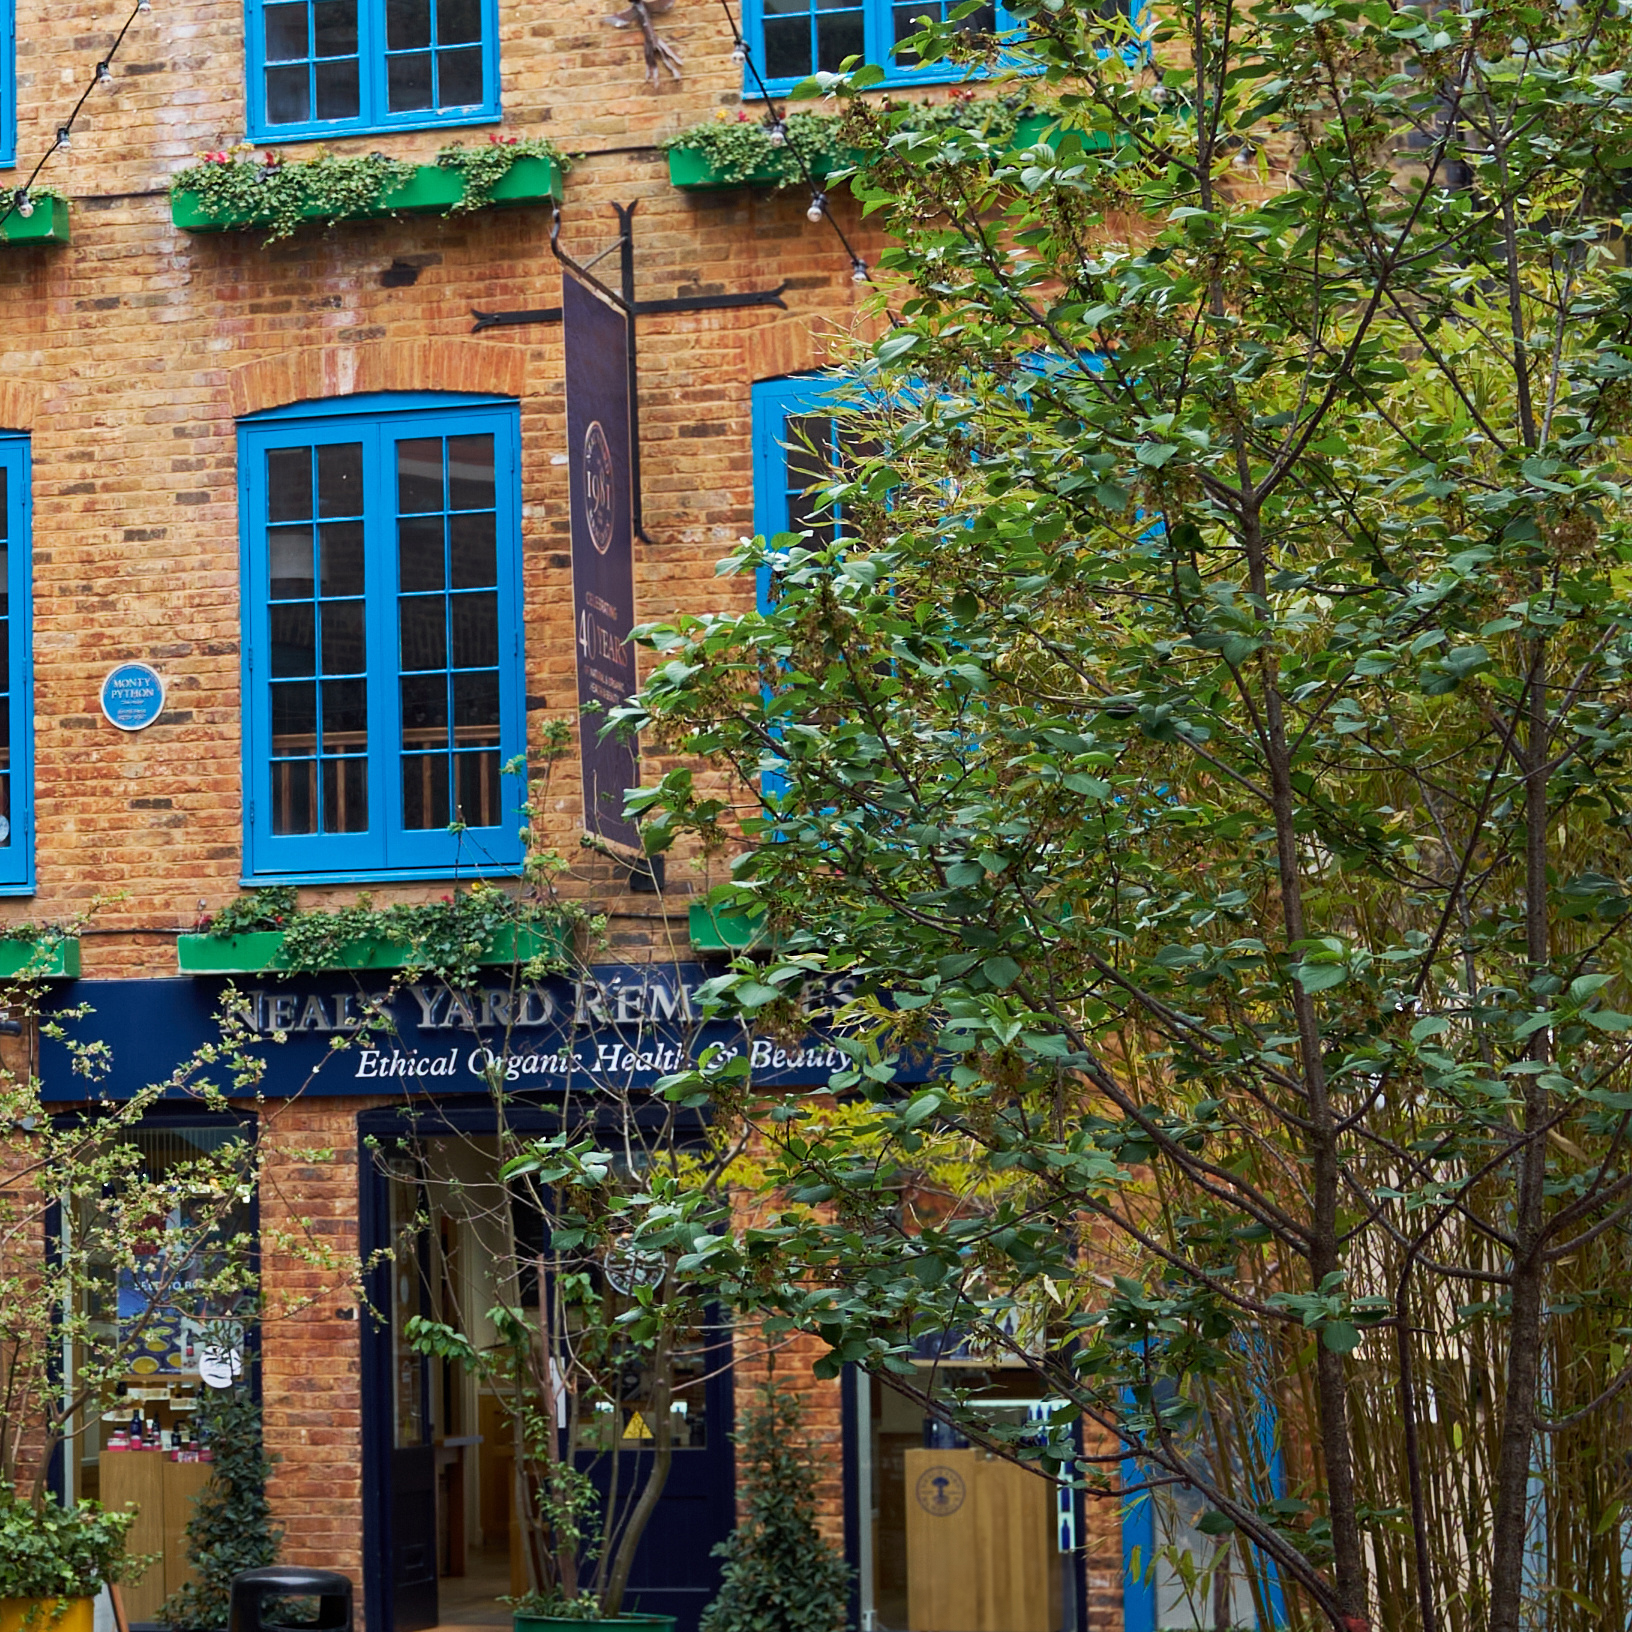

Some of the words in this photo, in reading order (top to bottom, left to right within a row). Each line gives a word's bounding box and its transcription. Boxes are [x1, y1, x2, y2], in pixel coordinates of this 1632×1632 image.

[587, 466, 611, 512] 1981
[579, 609, 596, 660] 40
[597, 625, 628, 667] YEARS
[111, 688, 154, 699] PYTHON
[114, 678, 151, 688] MONTY
[407, 984, 554, 1028] YARD
[355, 1047, 459, 1078] Ethical
[467, 1047, 583, 1081] Organic
[750, 1039, 853, 1074] Beauty
